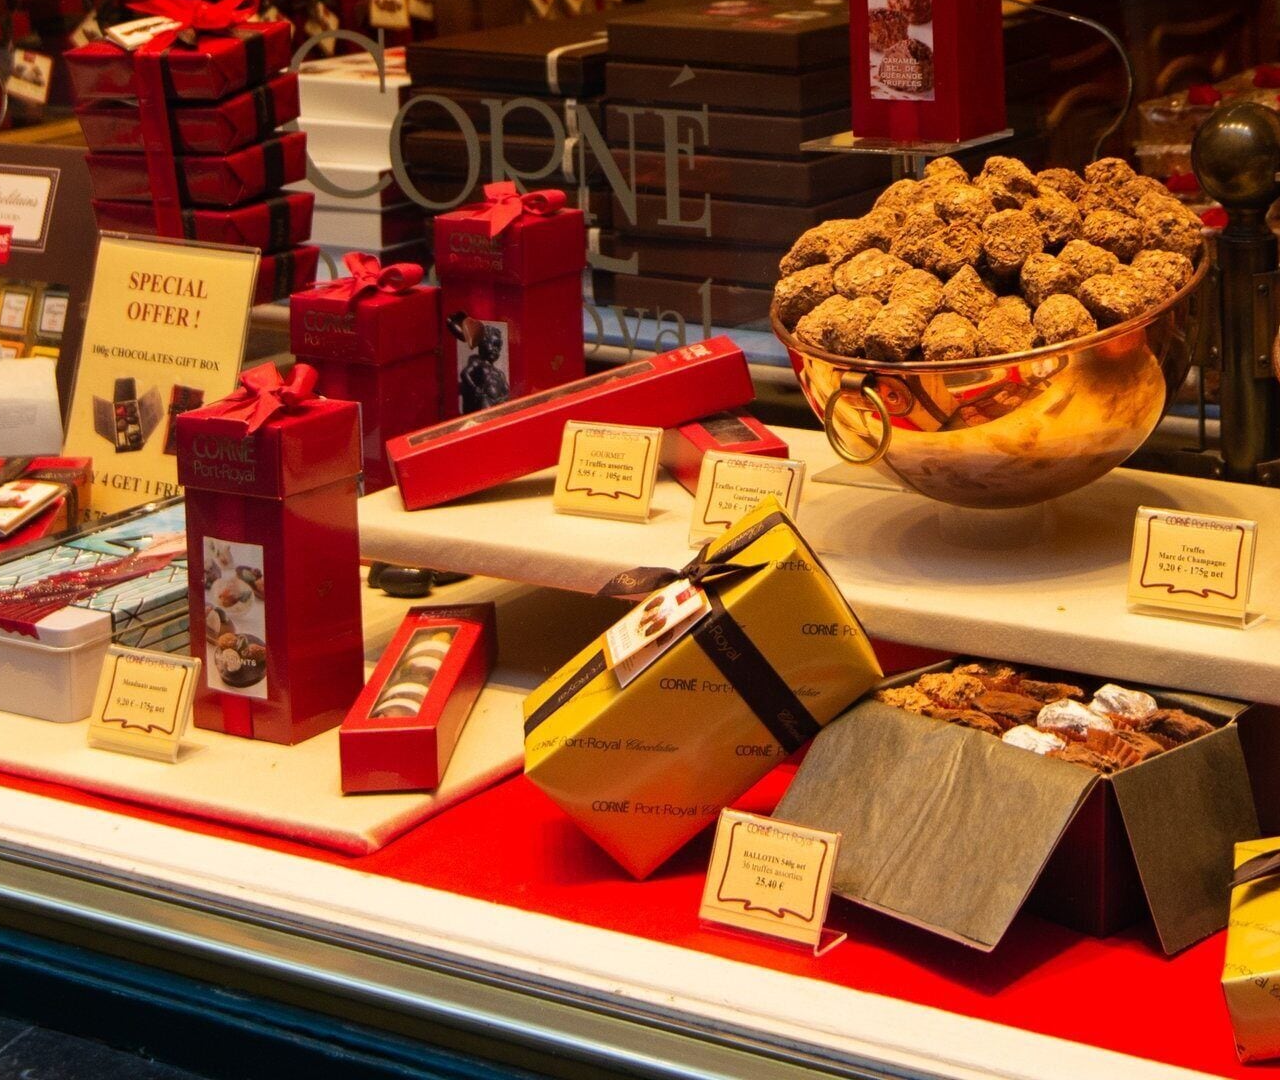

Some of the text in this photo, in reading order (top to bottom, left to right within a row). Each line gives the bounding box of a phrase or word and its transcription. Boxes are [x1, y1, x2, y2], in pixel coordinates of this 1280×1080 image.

[128, 270, 208, 299] SPECIAL
[127, 300, 190, 328] OFFER
[92, 344, 220, 371] 100g CHOCOLATES GIFT BOX
[590, 450, 626, 460] GOURMET
[102, 471, 109, 488] 4
[112, 473, 141, 493] GET
[1181, 544, 1205, 554] Truffes
[1159, 552, 1227, 567] Marc de Champagne
[1159, 563, 1175, 572] 9,20
[1190, 566, 1209, 578] 175g
[1211, 570, 1224, 578] net
[802, 623, 838, 636] CORNÉ
[660, 677, 697, 691] CORNÉ
[592, 800, 629, 813] CORNÉ
[635, 803, 697, 816] Port-Royal
[743, 850, 779, 864] BALLOTIN
[775, 869, 803, 881] assorties
[755, 877, 784, 890] 25,40 €
